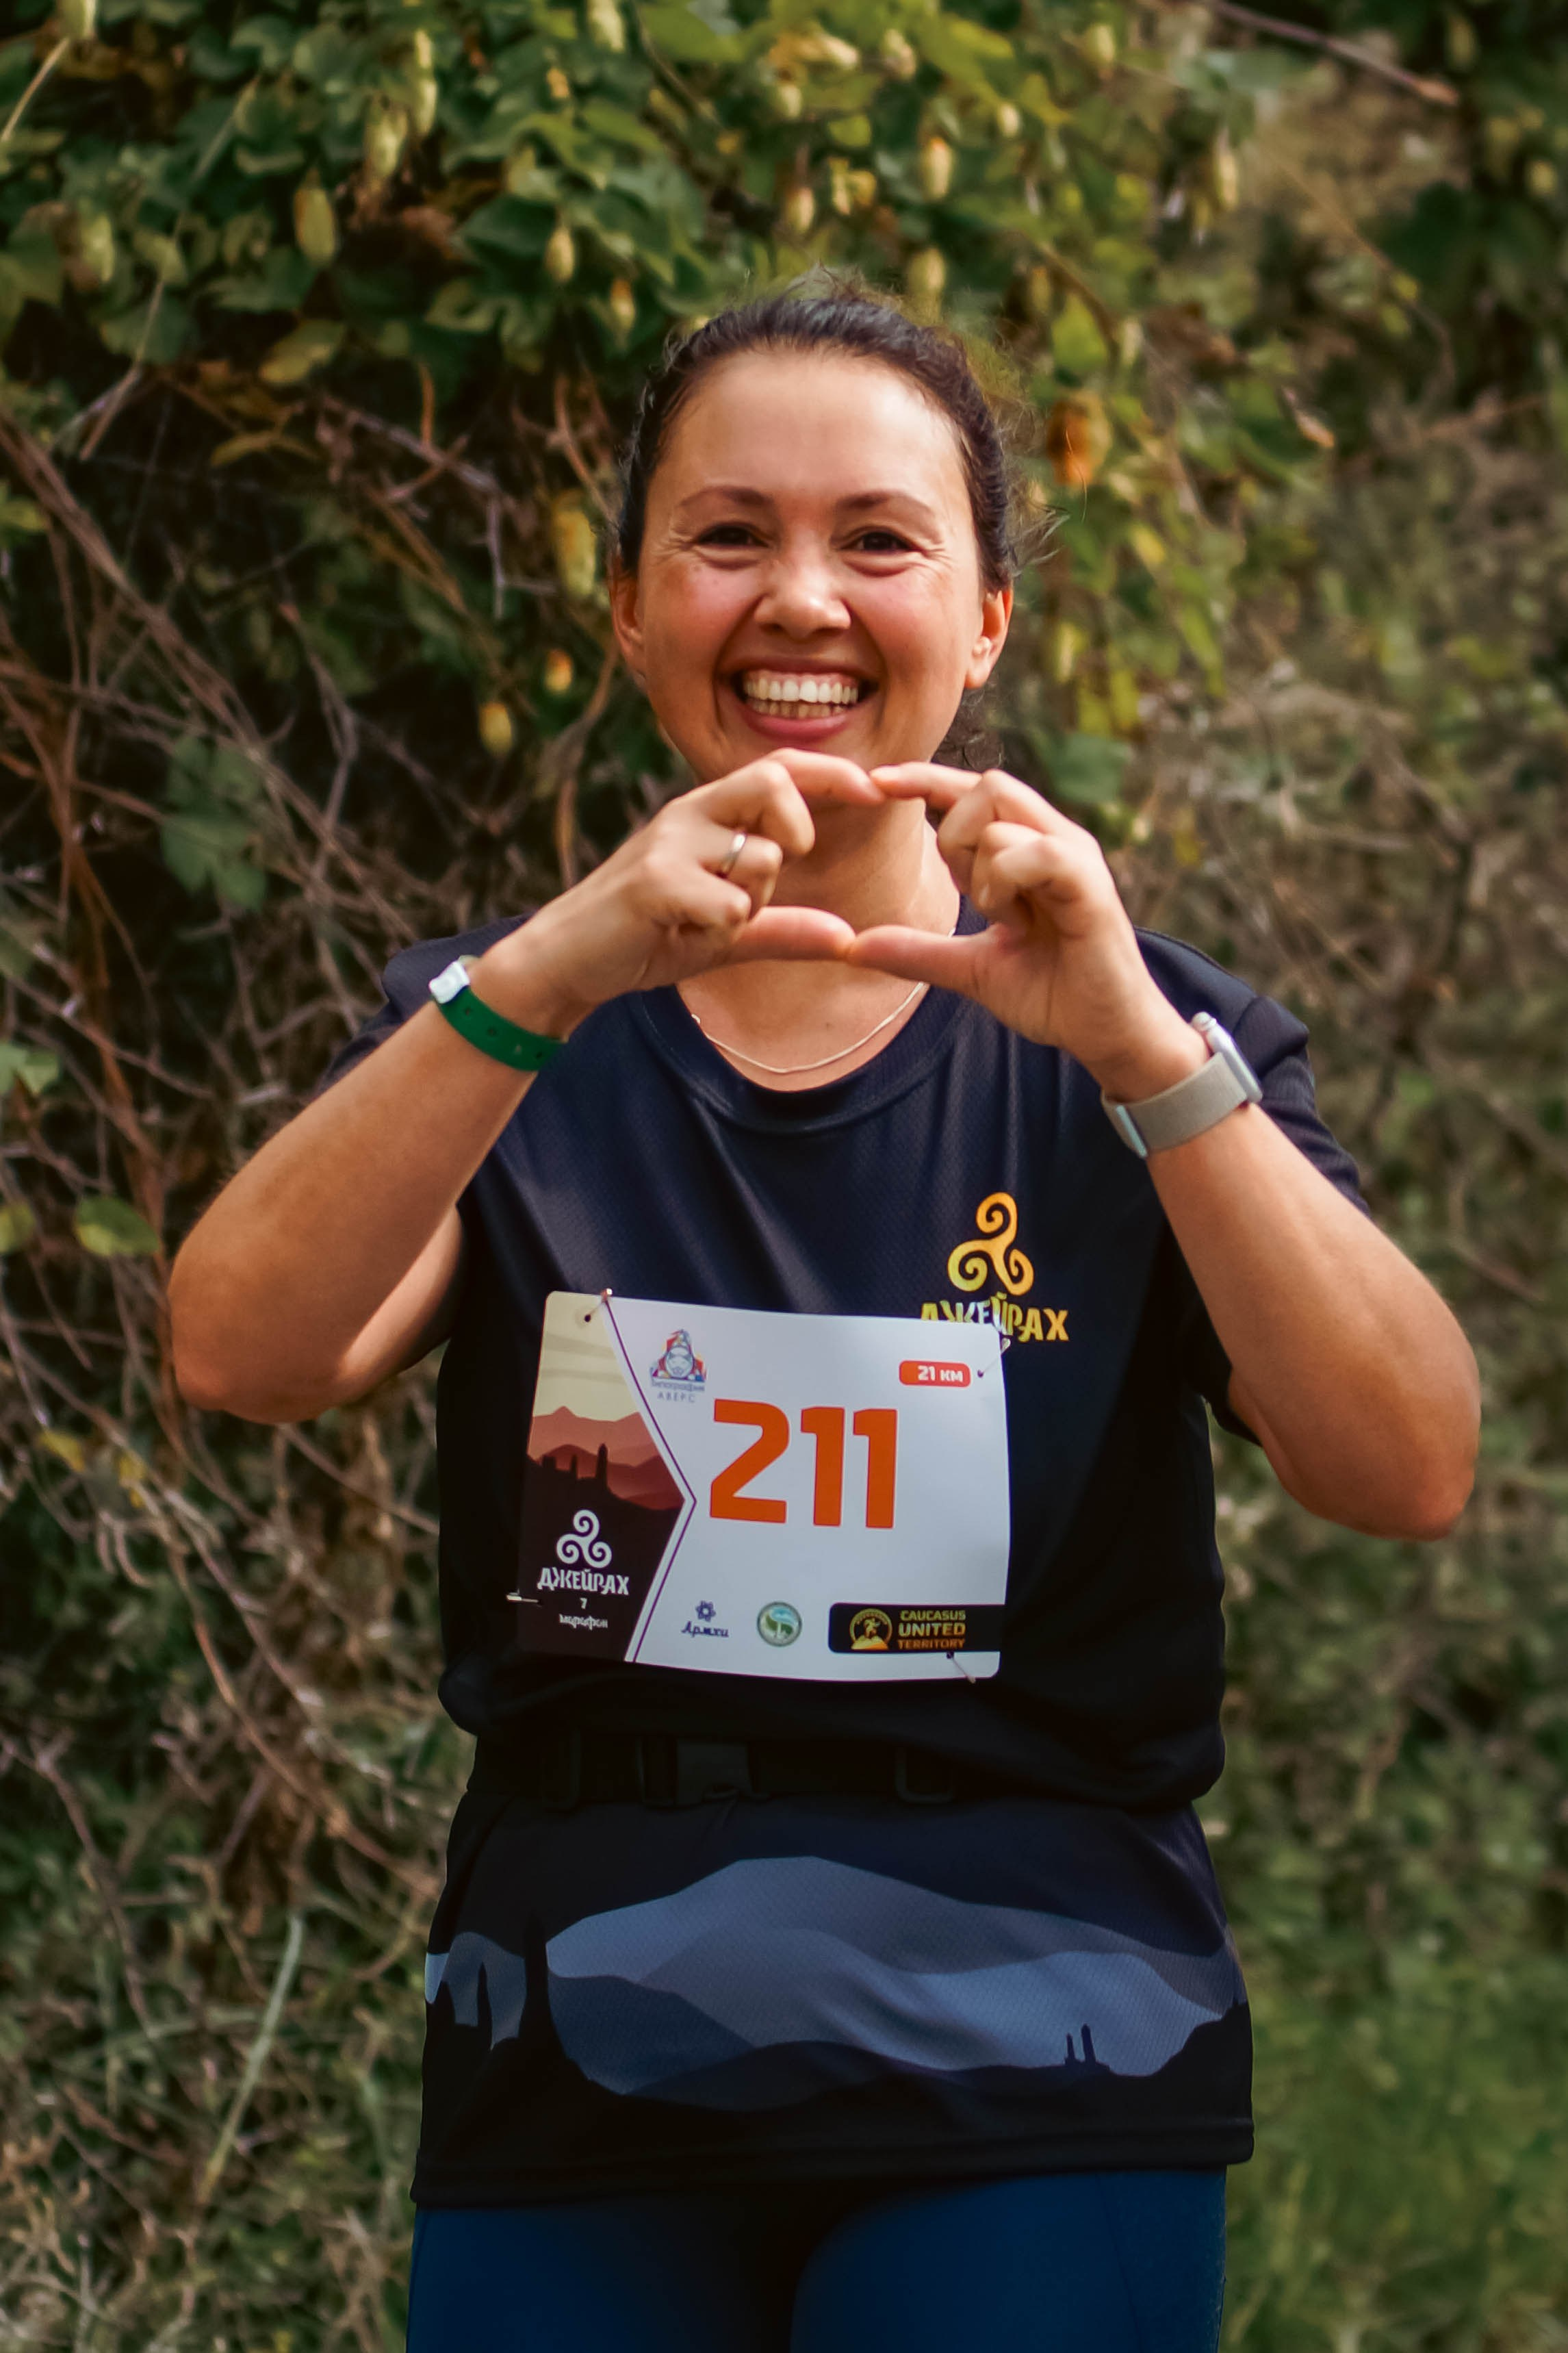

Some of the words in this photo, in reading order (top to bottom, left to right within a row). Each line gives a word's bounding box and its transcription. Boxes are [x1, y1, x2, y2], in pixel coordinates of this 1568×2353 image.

[918, 1365, 936, 1381] 21
[710, 1398, 898, 1529] 211
[537, 1566, 630, 1596] ДЖЕЙРАХ
[580, 1597, 588, 1610] 7
[900, 1610, 966, 1621] CAUCASUS
[898, 1623, 966, 1637] UNITED
[897, 1638, 966, 1649] TERRITORY
